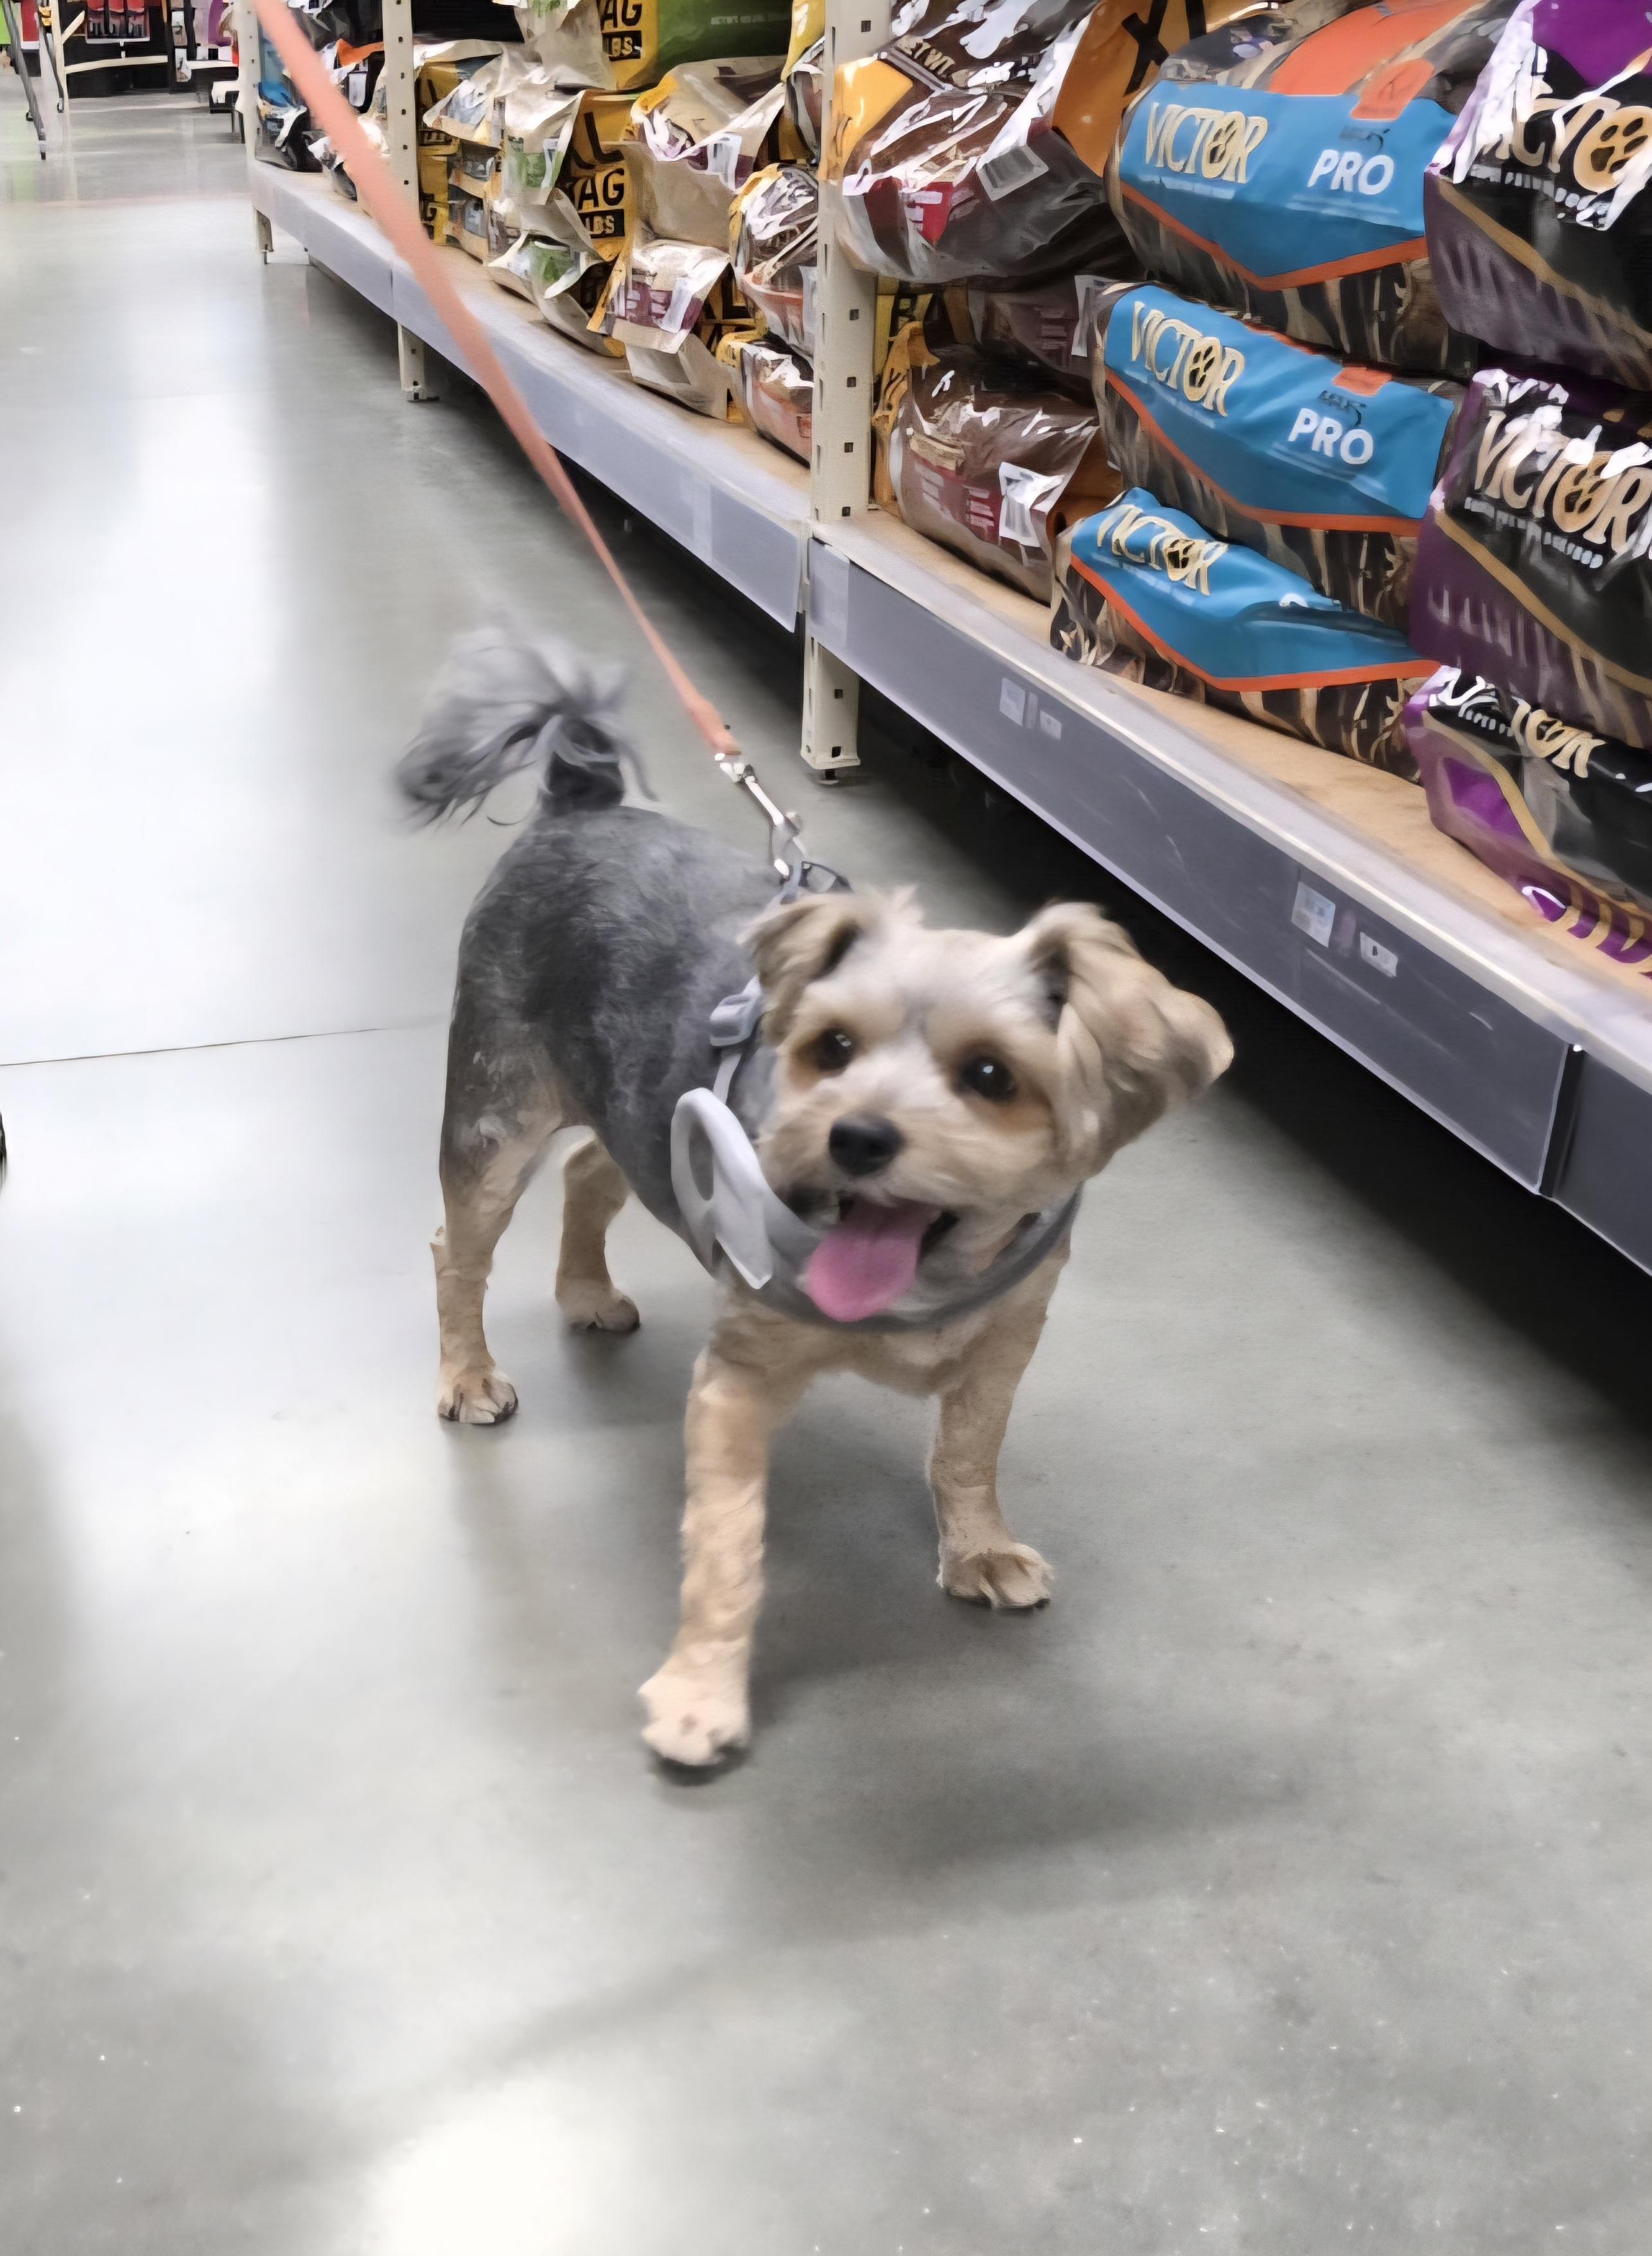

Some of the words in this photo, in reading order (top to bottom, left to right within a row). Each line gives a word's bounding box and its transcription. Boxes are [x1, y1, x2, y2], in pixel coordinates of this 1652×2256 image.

[1145, 102, 1268, 184] VICTOR
[1307, 149, 1394, 195] PRO
[1132, 301, 1245, 417] VICTOR
[1288, 408, 1373, 465] PRO
[1097, 504, 1228, 596] VICTOR
